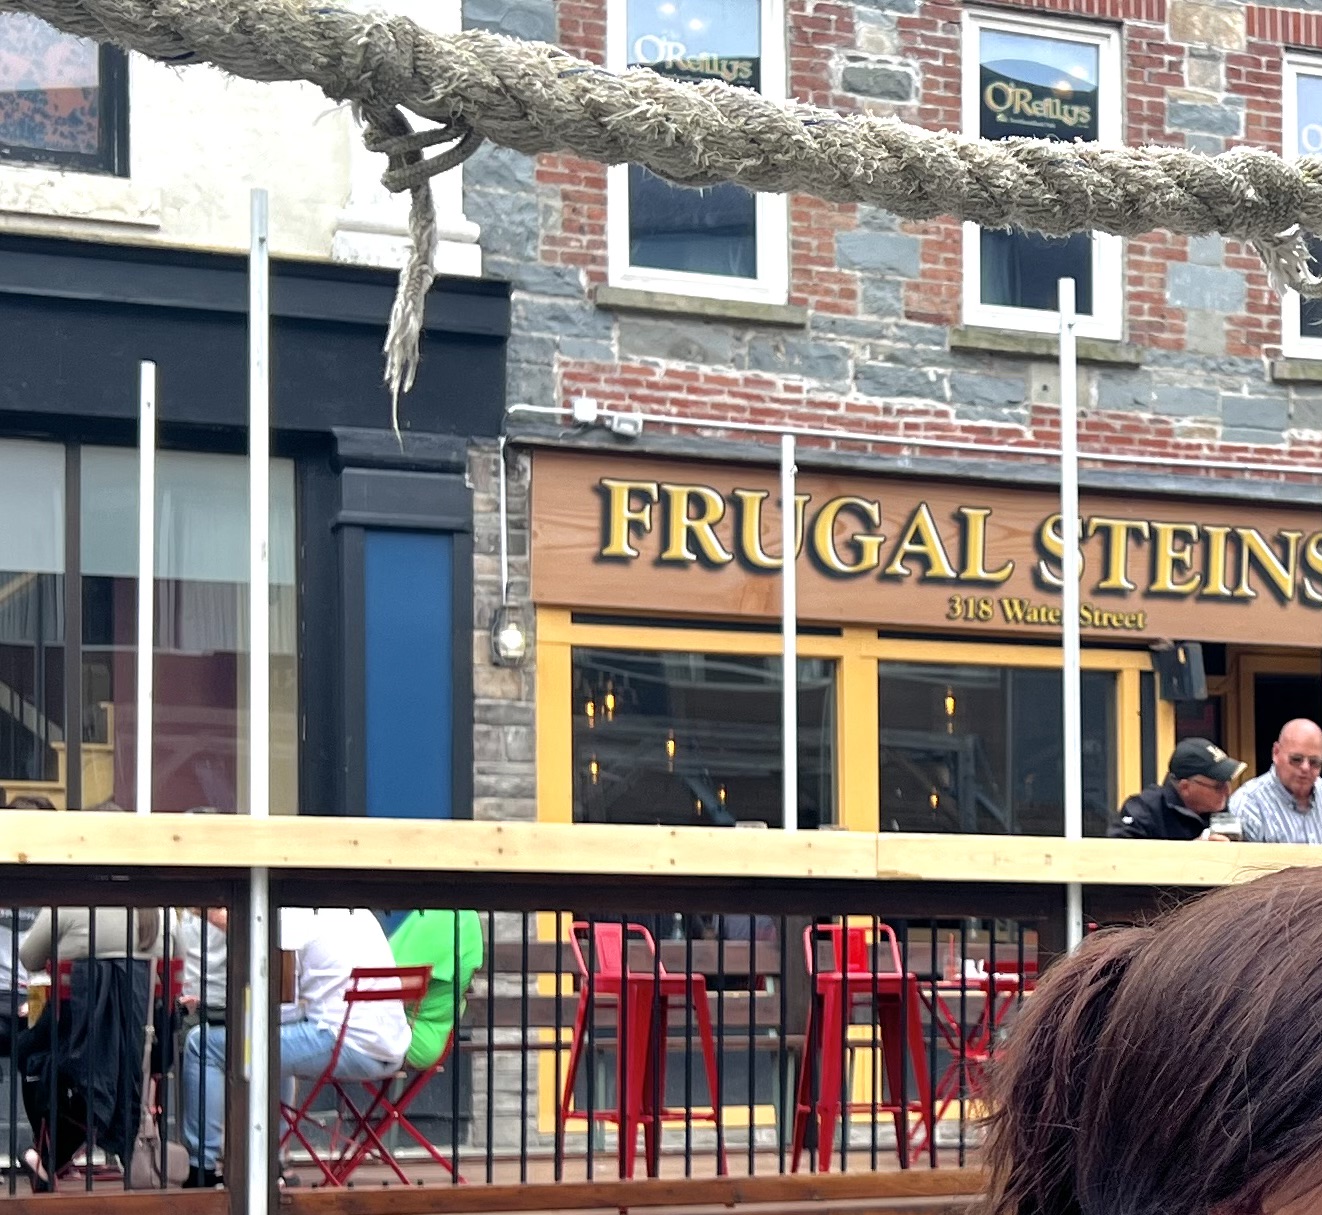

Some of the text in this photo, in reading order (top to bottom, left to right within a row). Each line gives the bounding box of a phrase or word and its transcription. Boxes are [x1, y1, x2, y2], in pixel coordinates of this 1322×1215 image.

[600, 478, 1013, 582] FRUGAL
[947, 595, 1146, 629] 318 Wate Street
